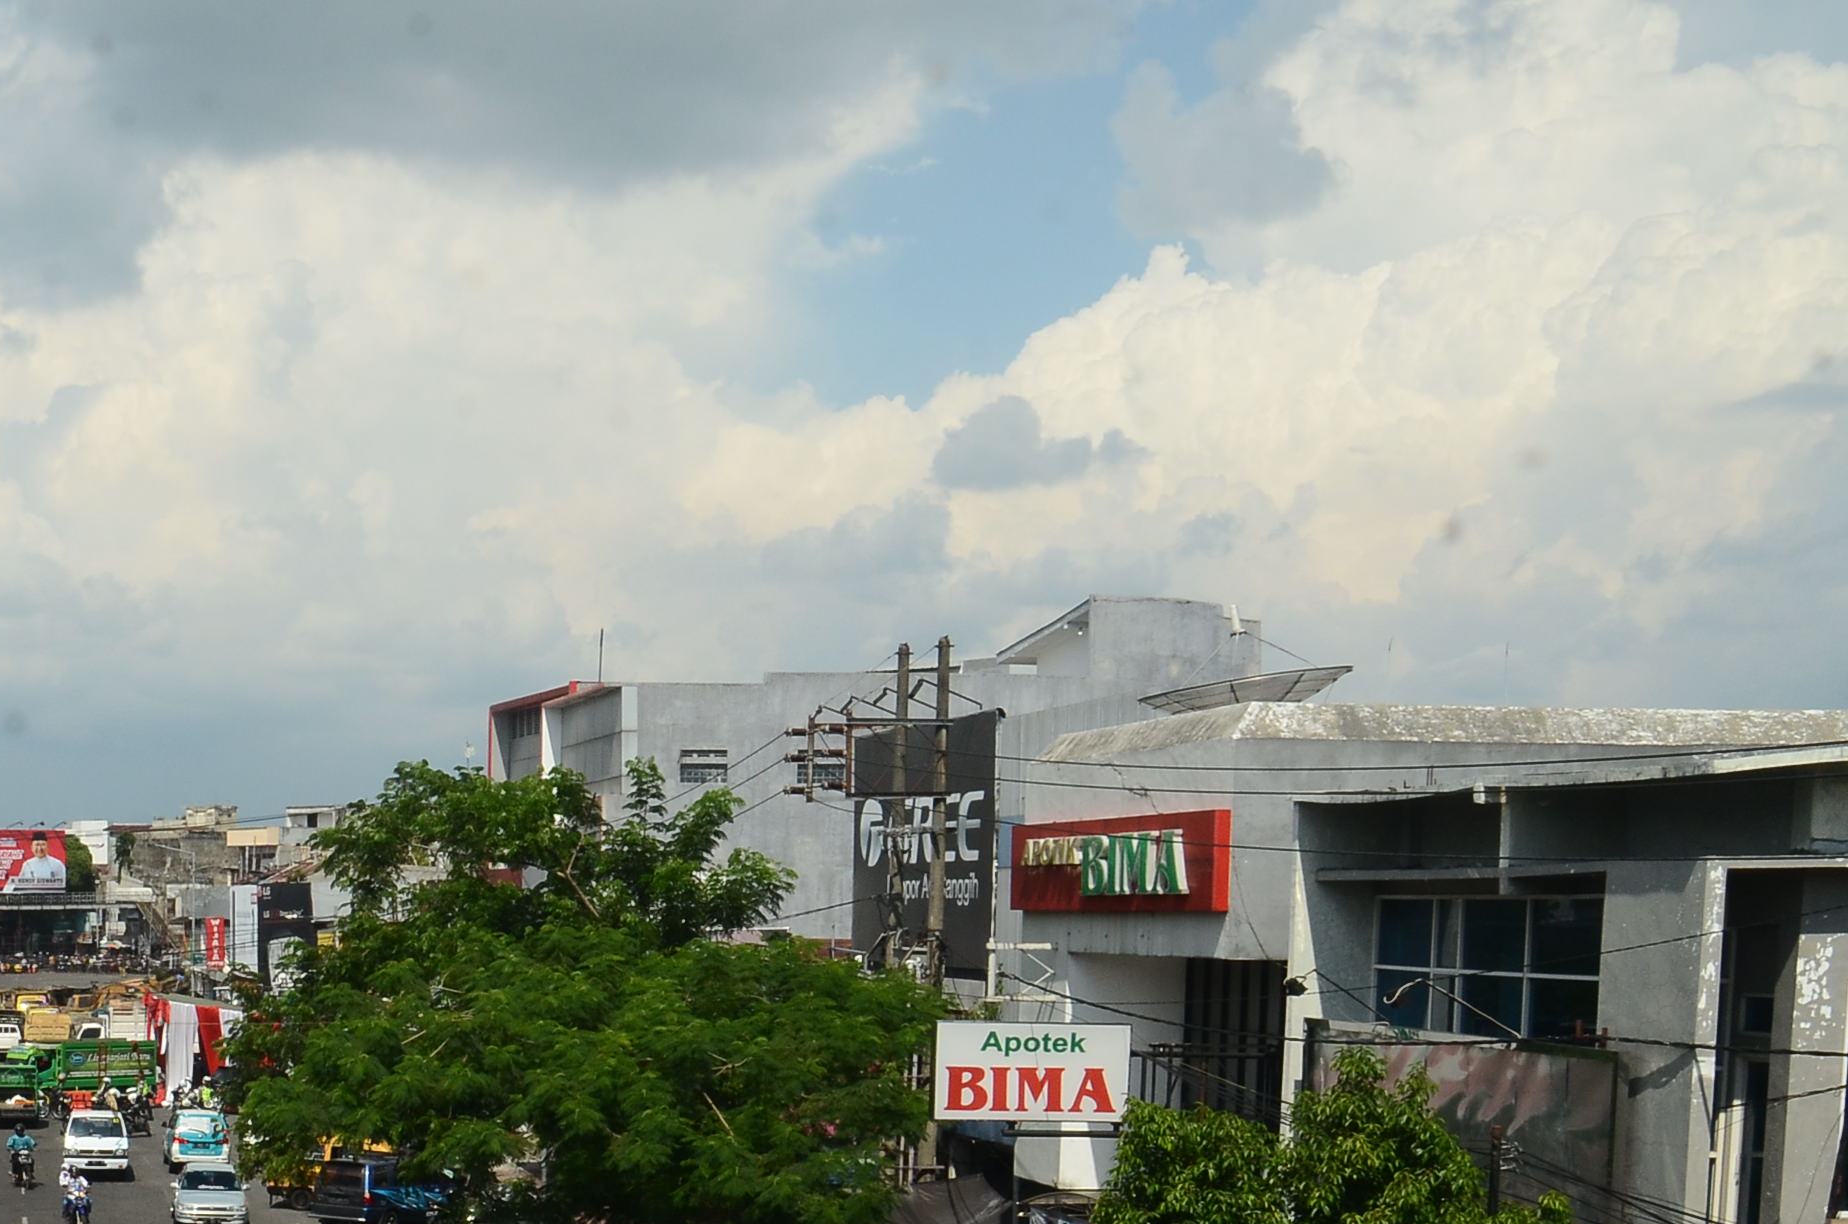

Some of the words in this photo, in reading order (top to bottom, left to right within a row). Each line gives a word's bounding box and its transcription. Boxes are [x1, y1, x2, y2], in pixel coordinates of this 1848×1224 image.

[1021, 837, 1080, 866] APOTIK
[1080, 828, 1191, 896] BIMA
[210, 919, 221, 961] WIJAYA
[981, 1030, 1086, 1057] Apotek
[944, 1066, 1116, 1113] BIMA
